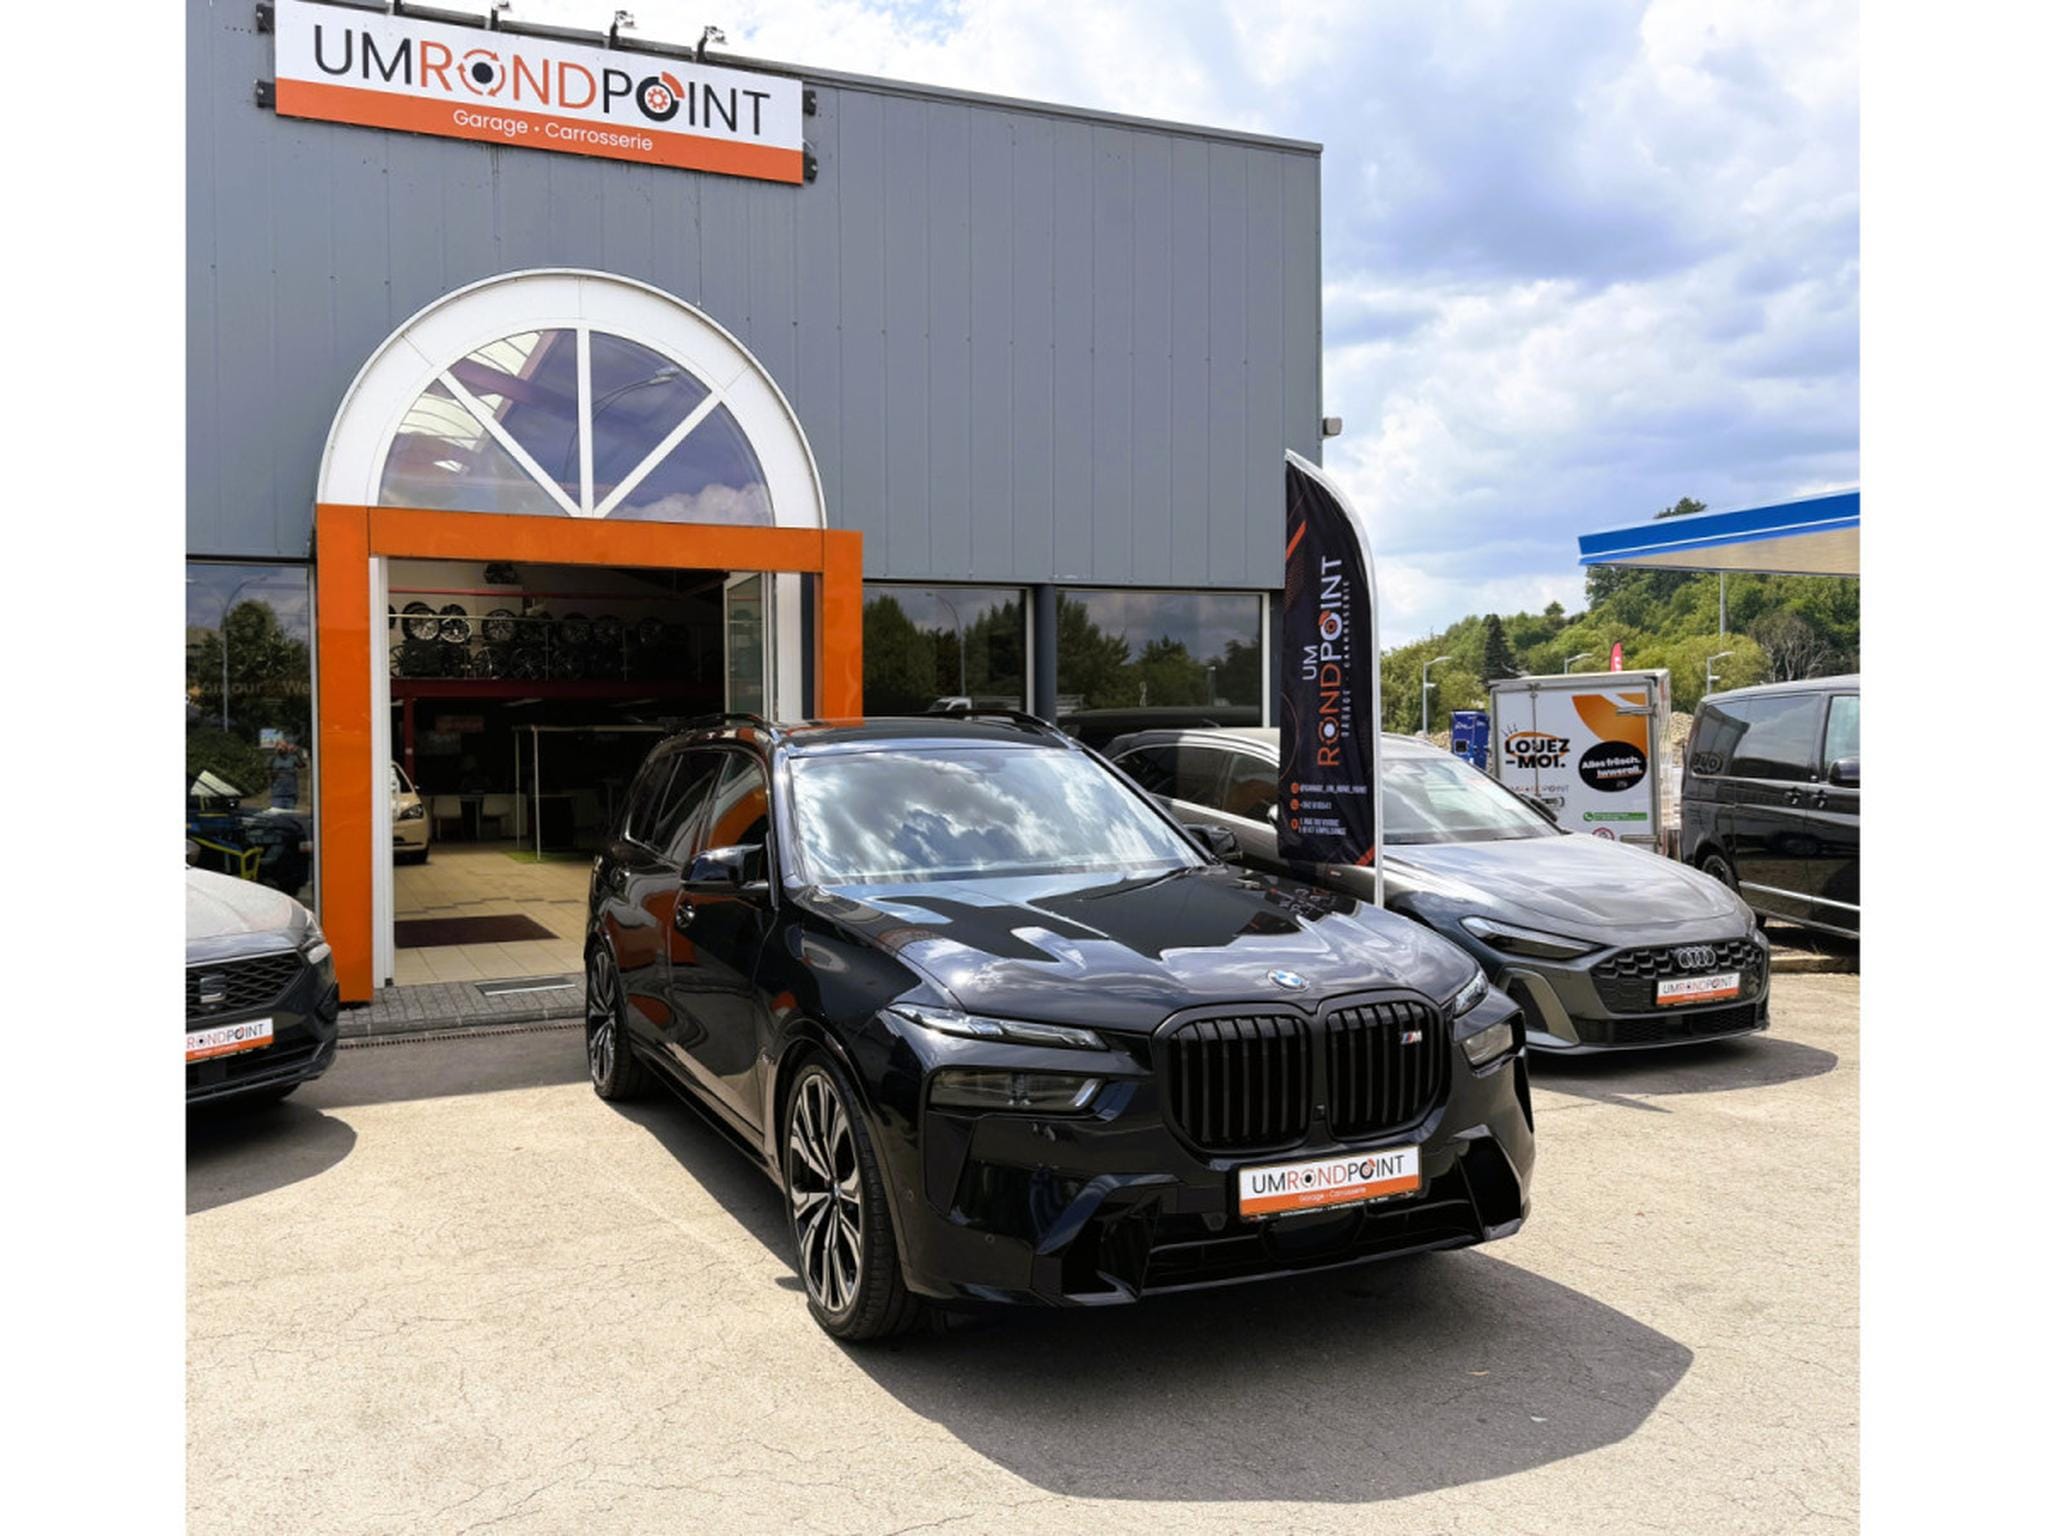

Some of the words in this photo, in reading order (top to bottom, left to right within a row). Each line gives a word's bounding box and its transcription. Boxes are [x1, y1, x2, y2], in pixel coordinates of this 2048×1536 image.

[453, 109, 528, 137] Garage
[545, 122, 653, 151] Carrosserie
[1302, 645, 1318, 680] UM
[1318, 556, 1342, 766] RONDPOINT
[1505, 739, 1570, 754] LOUEZ
